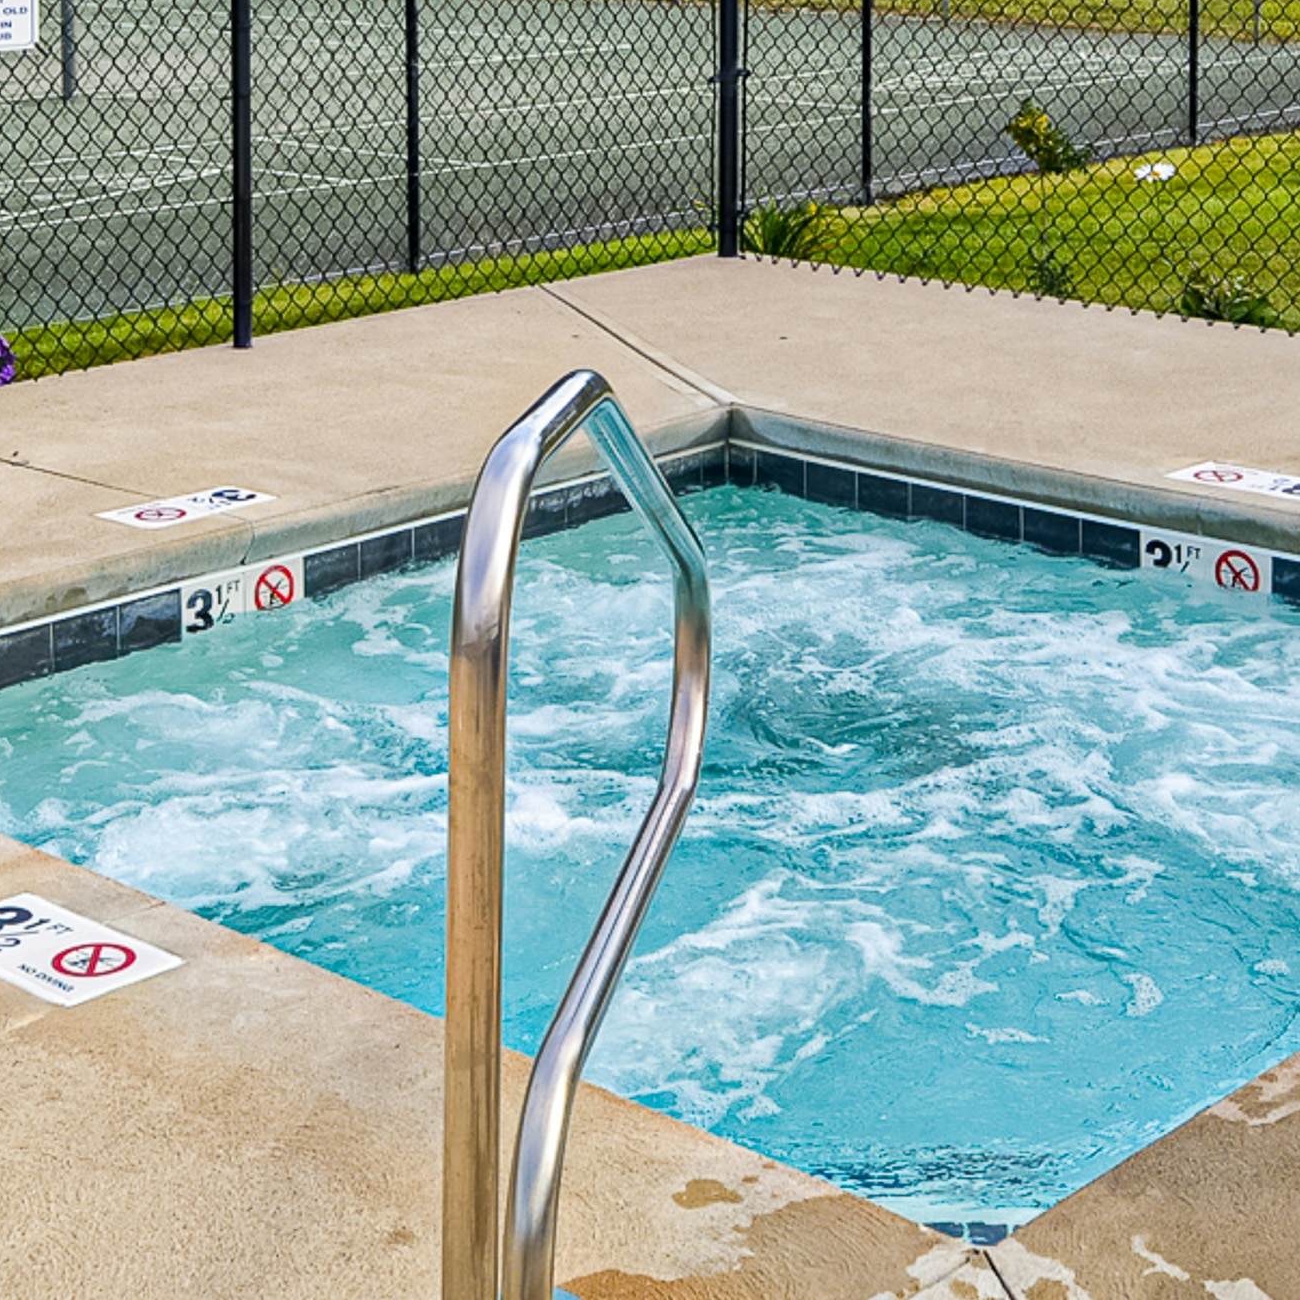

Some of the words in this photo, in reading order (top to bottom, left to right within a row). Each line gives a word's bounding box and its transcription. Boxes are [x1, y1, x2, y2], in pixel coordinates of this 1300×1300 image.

[3, 6, 27, 16] OLD
[0, 20, 12, 29] IN
[48, 923, 74, 935] FT
